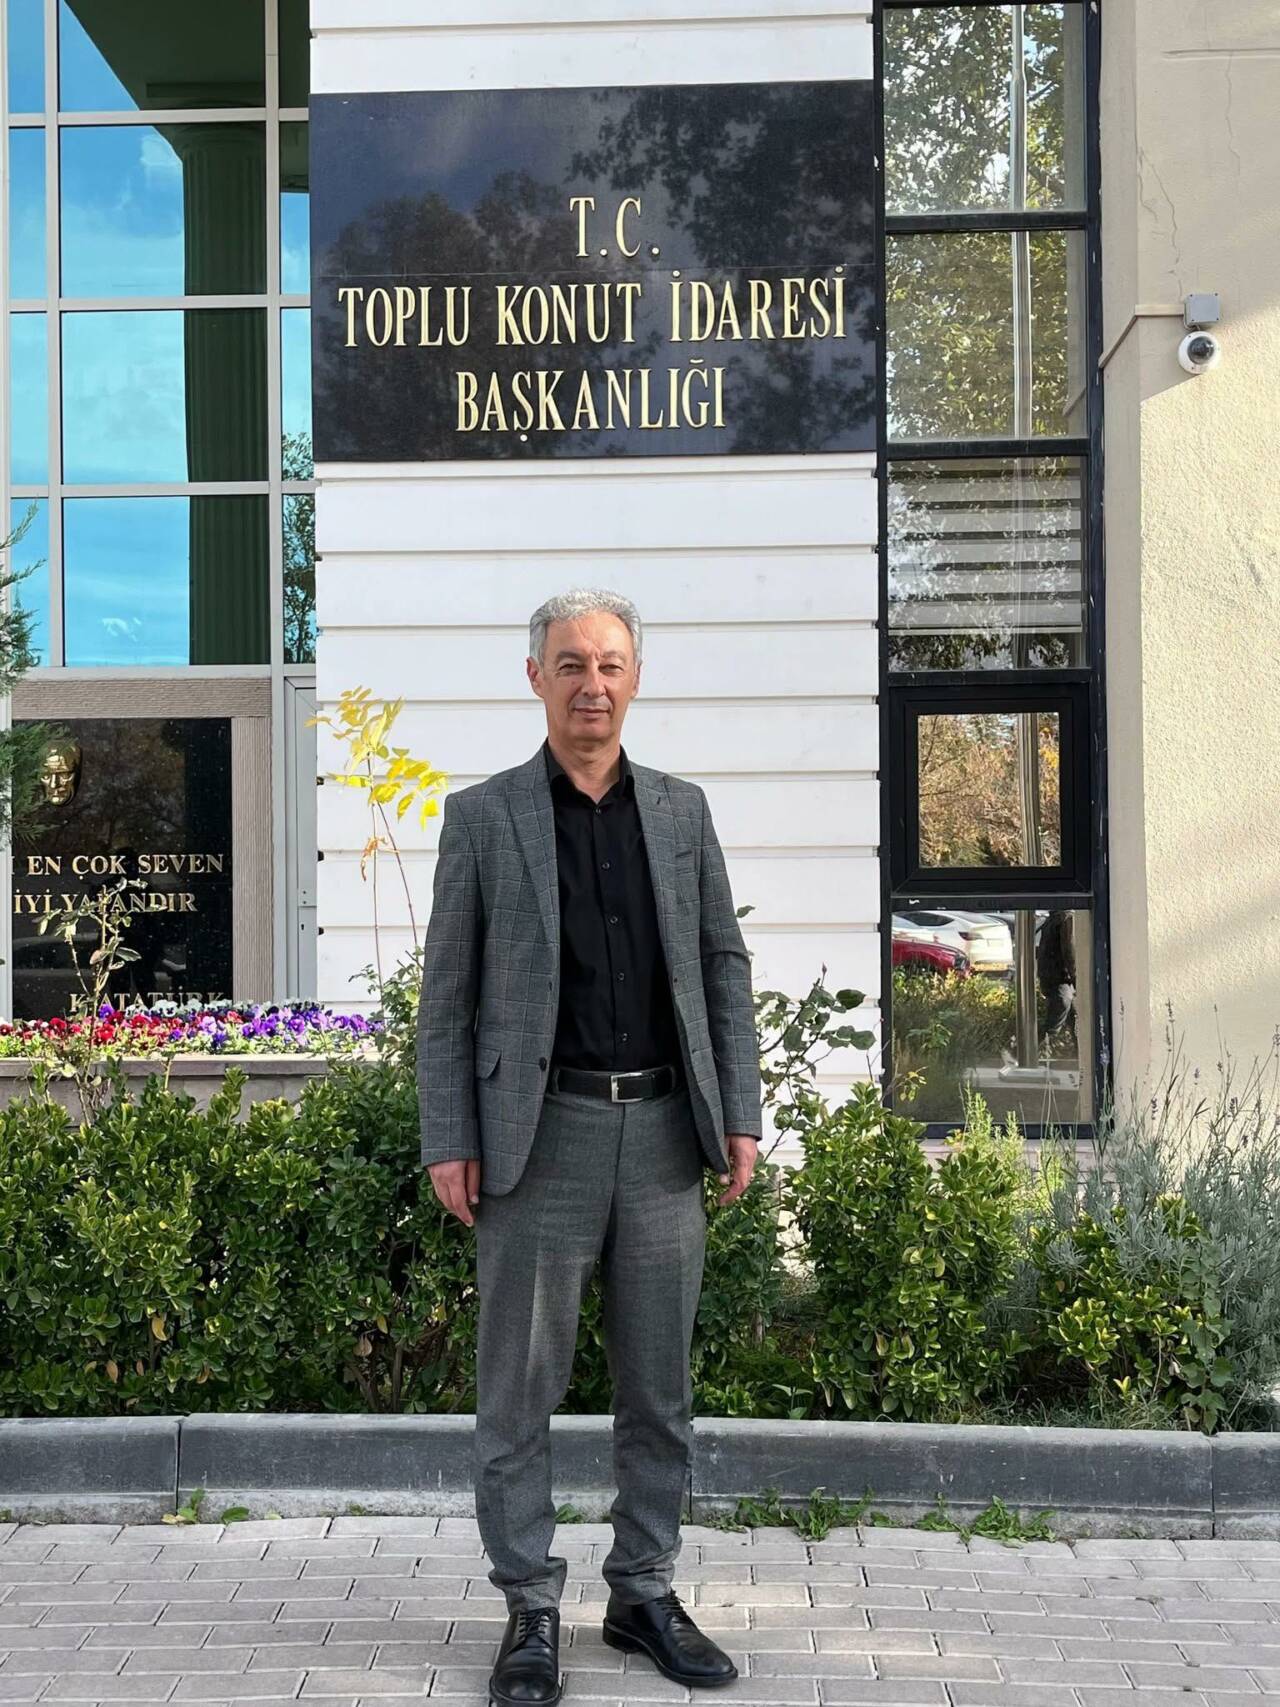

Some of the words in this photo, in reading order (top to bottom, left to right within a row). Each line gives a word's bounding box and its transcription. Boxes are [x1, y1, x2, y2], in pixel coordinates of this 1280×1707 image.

[338, 286, 473, 347] TOPLU
[495, 282, 642, 345] KONUT
[669, 265, 848, 342] İDARESİ
[455, 358, 727, 442] BAŞKANLIĞI
[27, 855, 62, 876] EN
[72, 855, 127, 880] ÇOK
[138, 853, 224, 874] SEVEN
[13, 888, 53, 914] İYİ
